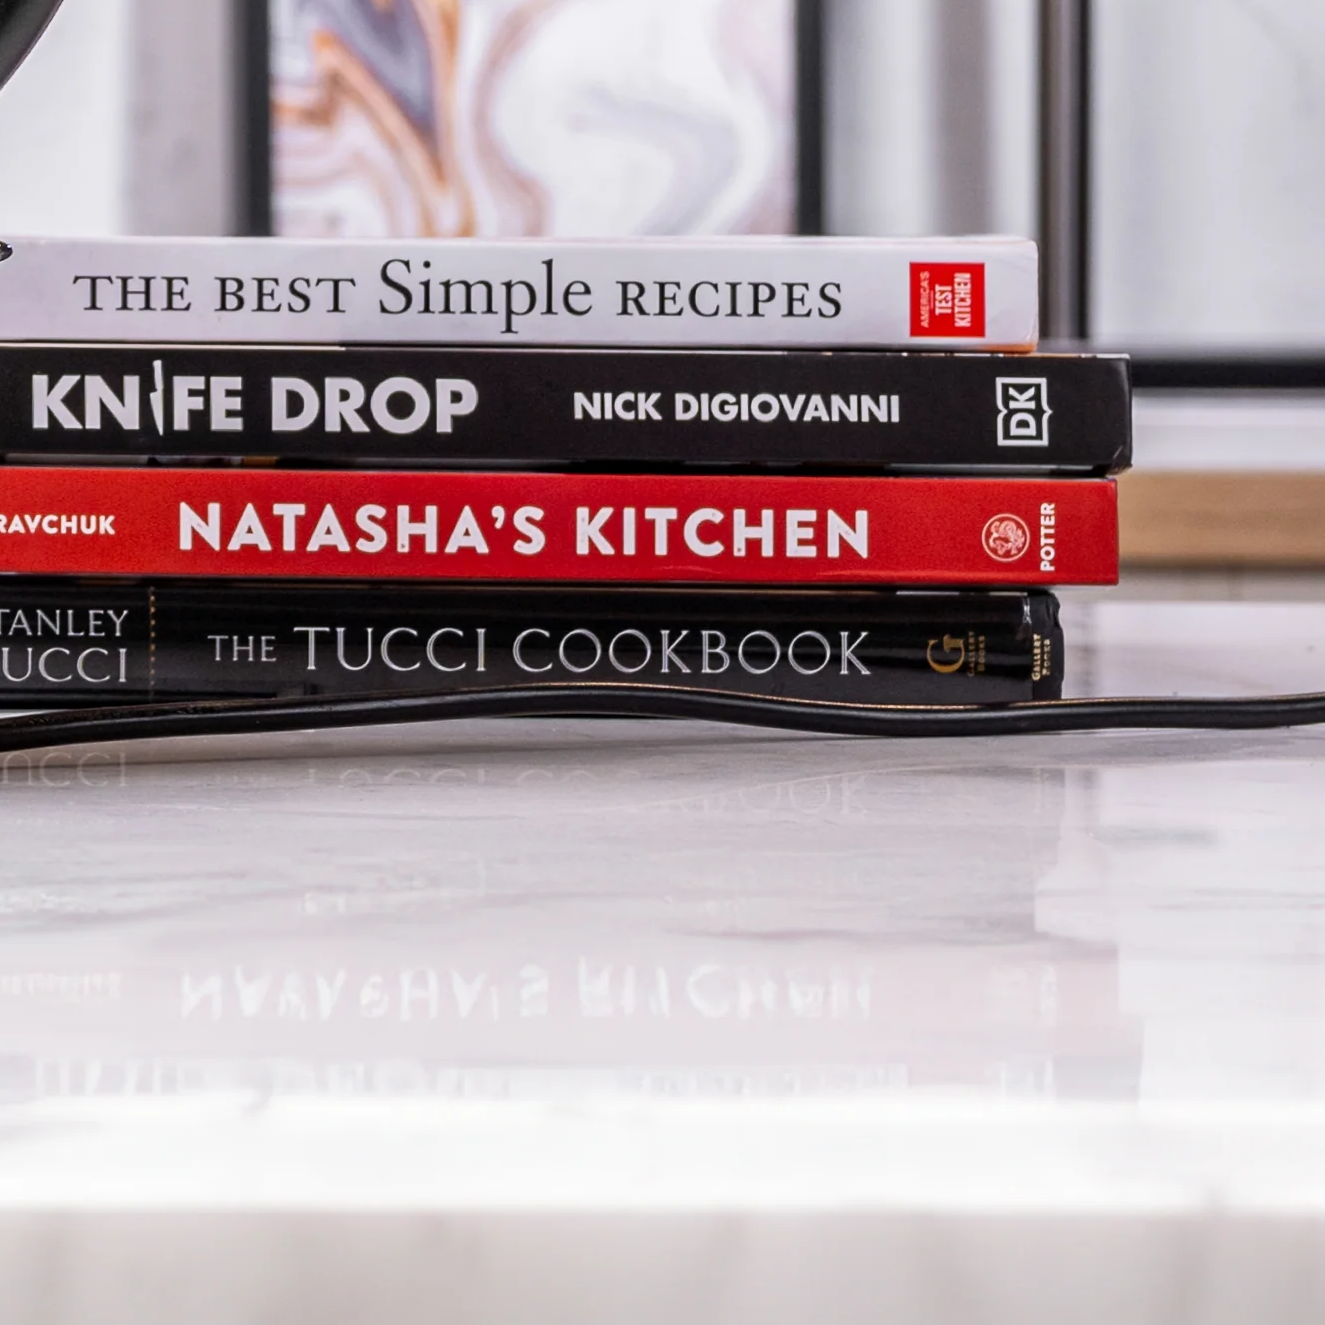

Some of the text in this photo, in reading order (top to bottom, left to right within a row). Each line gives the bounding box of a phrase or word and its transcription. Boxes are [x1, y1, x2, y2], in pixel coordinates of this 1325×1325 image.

[73, 258, 842, 334] THE BEST Simple RECIPES
[935, 283, 952, 316] TEST
[954, 272, 971, 327] KITCHEN
[32, 359, 479, 436] KNIFE DROP
[573, 392, 900, 423] NICK DIGIOVANNI
[1008, 386, 1037, 437] DK
[179, 501, 869, 559] NATASHA'S KITCHEN
[1040, 502, 1055, 571] POTTER
[208, 626, 871, 675] THE TUCCI COOKBOOK
